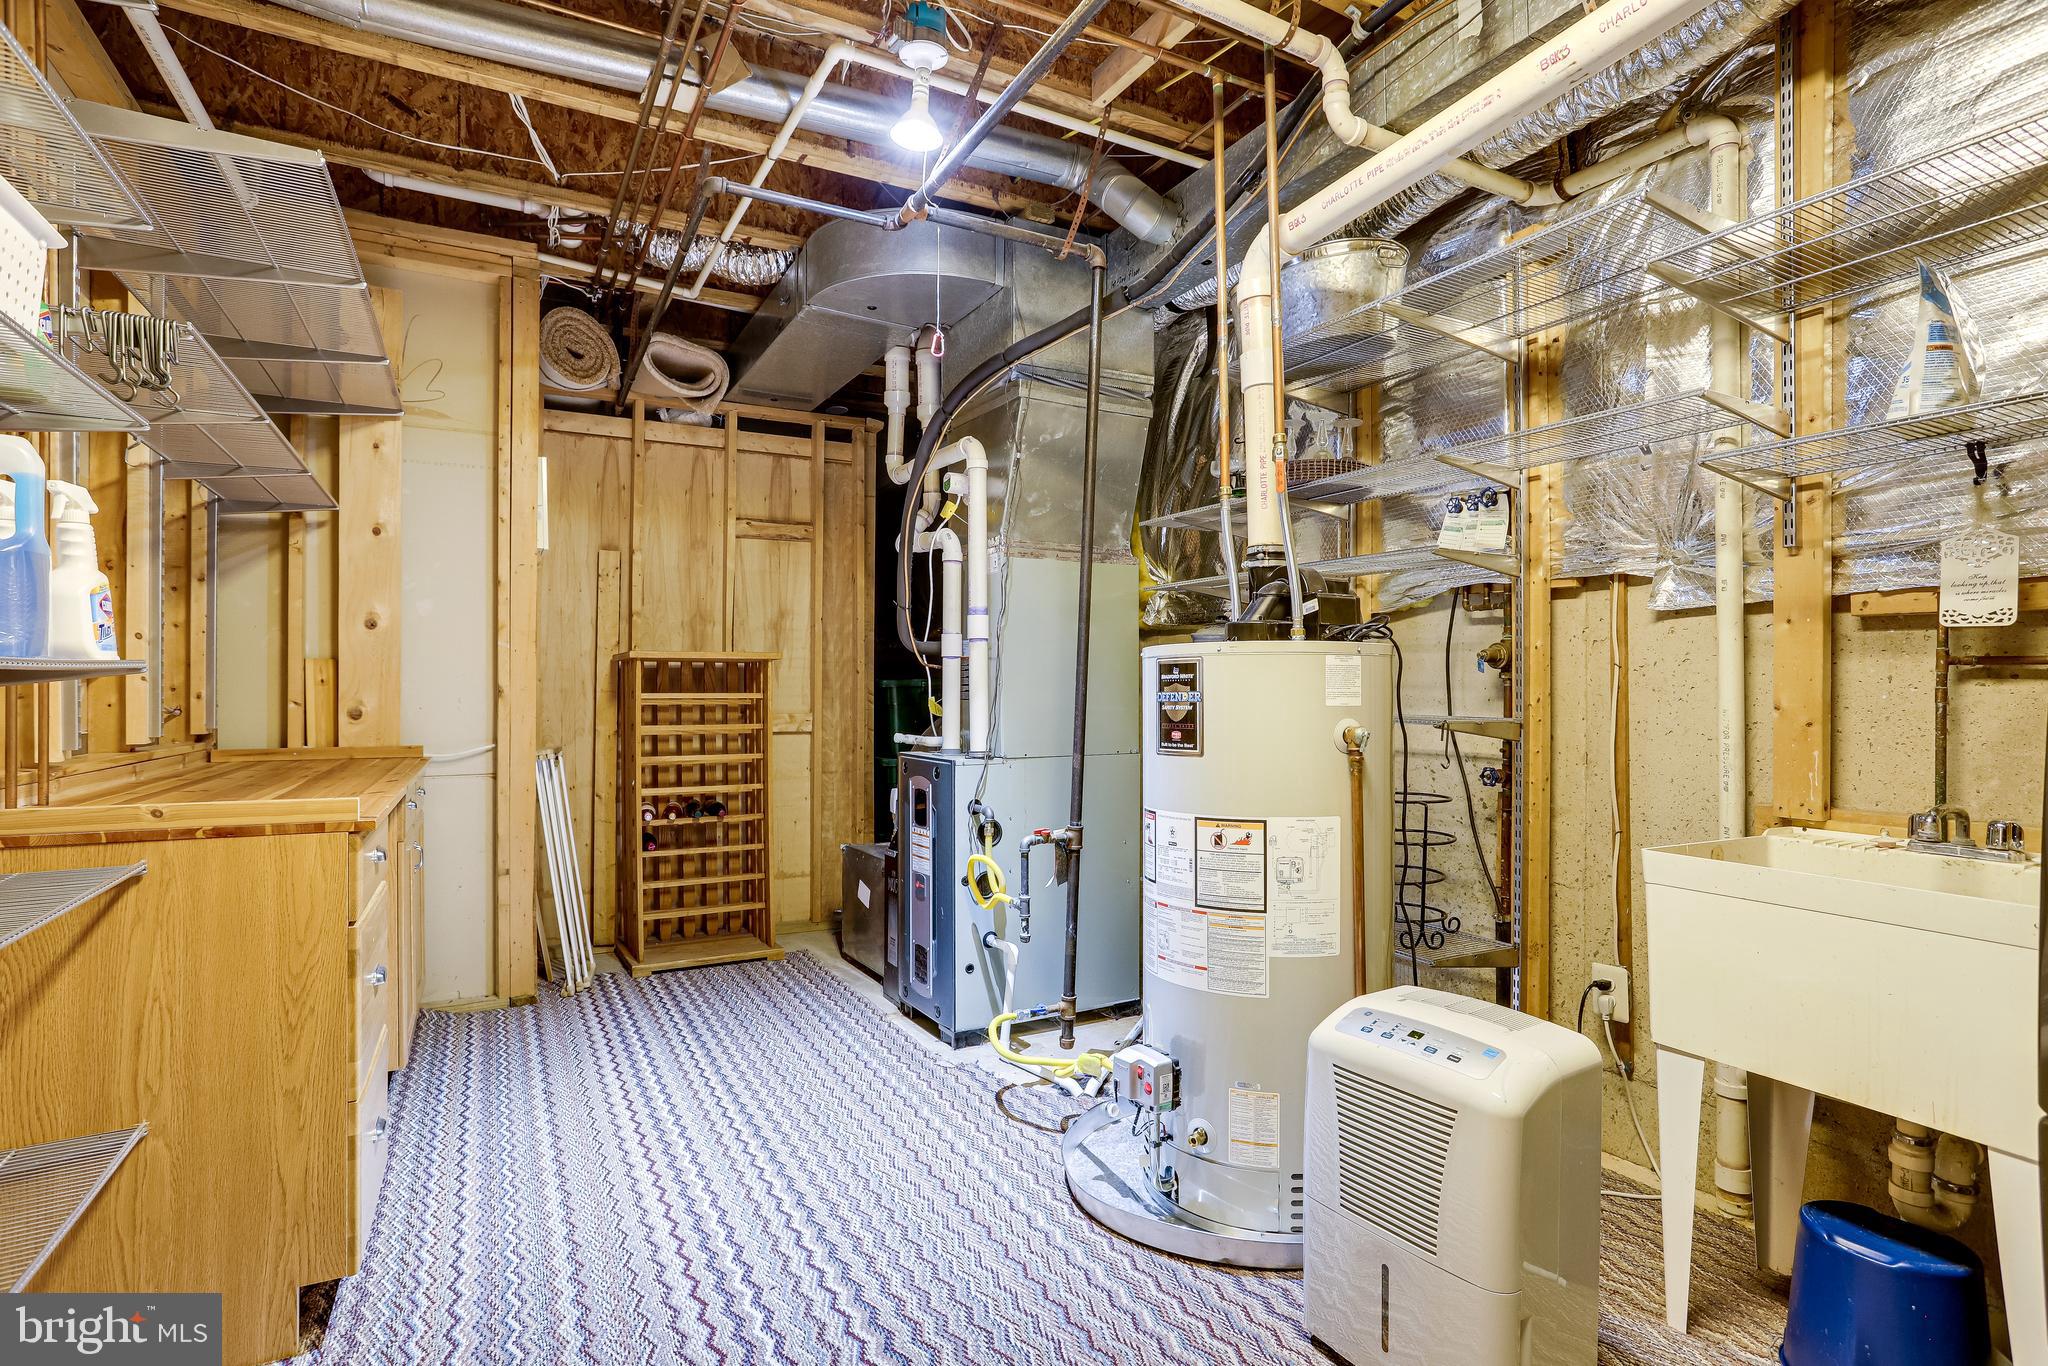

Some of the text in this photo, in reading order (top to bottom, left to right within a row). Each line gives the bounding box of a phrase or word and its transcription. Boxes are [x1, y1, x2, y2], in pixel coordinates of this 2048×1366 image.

[1320, 176, 1364, 210] CHARLOTTE
[1366, 164, 1385, 180] PIPE
[1260, 454, 1268, 470] PIPE
[1260, 472, 1268, 510] CHARLOTTE
[1950, 581, 1977, 589] looking
[1157, 691, 1202, 702] DEFENDER
